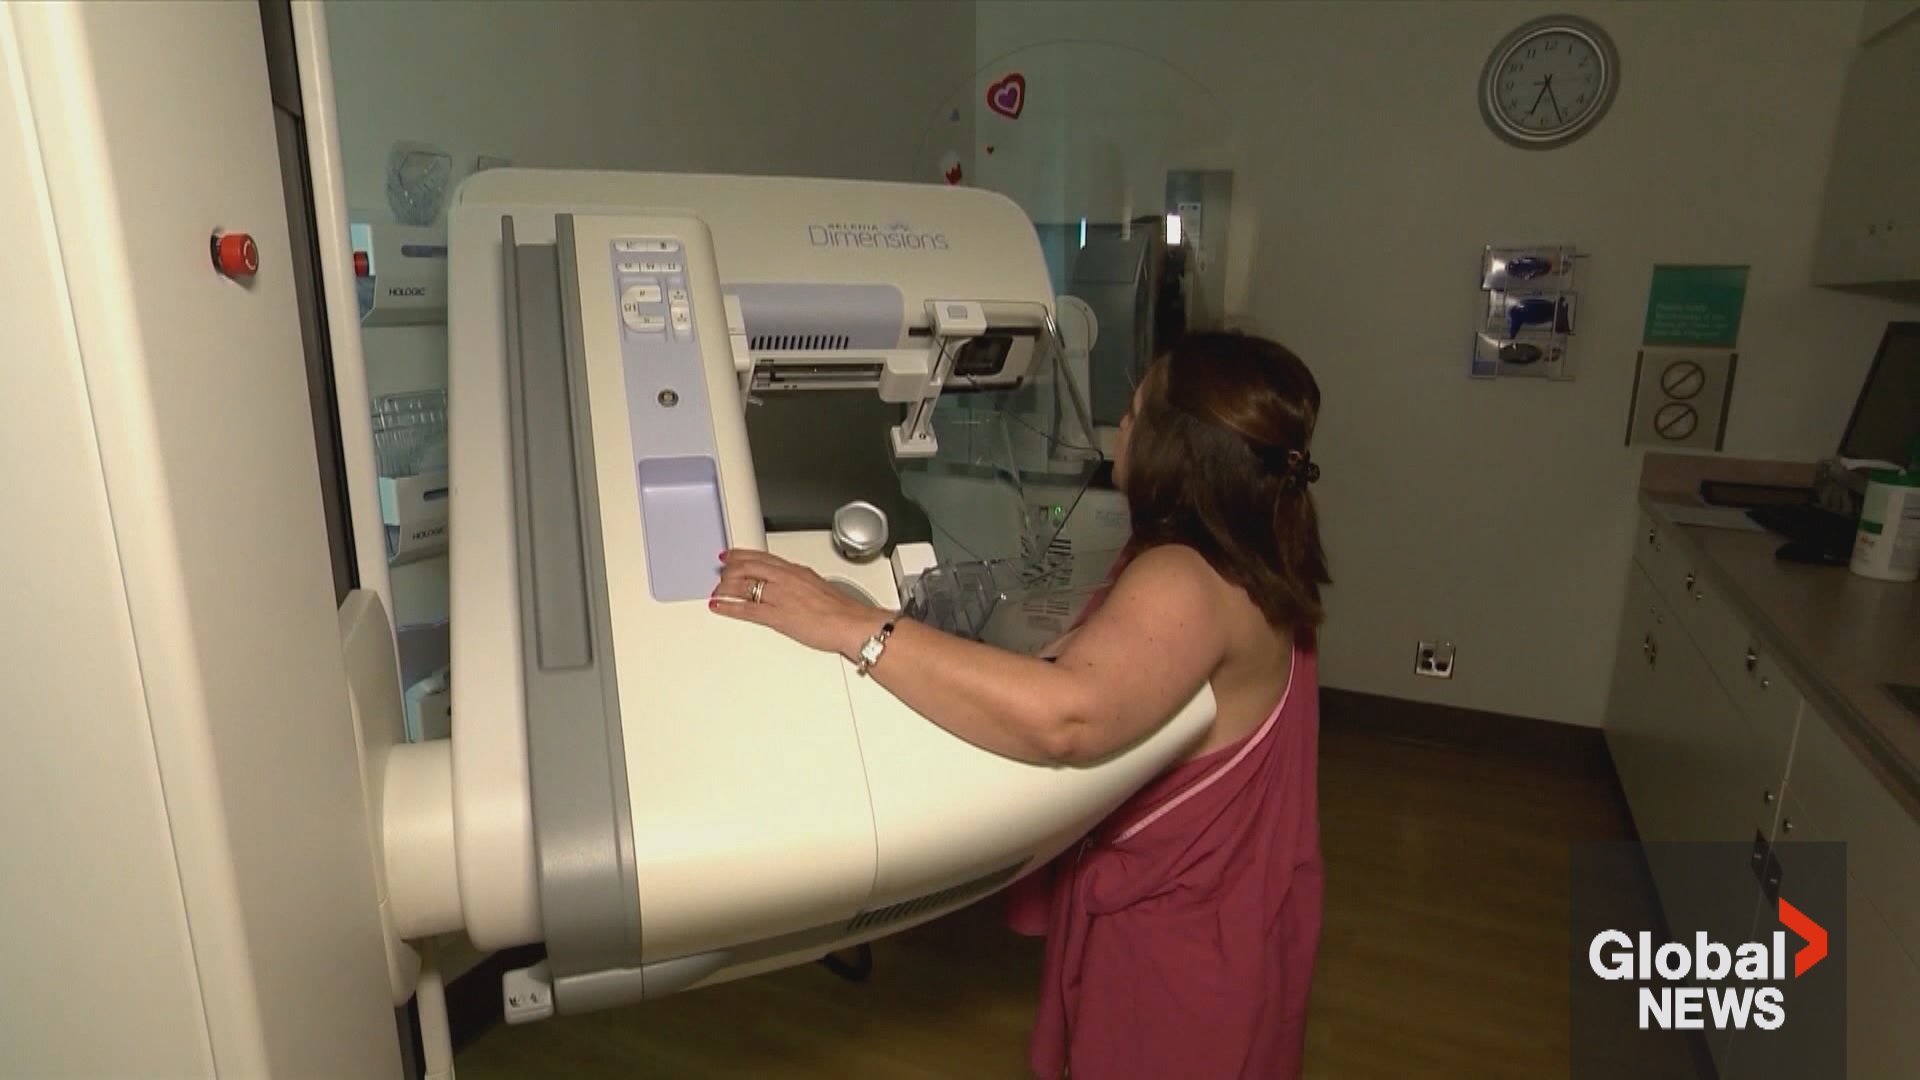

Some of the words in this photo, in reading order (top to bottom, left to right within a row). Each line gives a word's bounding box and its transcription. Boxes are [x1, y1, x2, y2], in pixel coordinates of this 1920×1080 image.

[1544, 40, 1559, 51] 12
[1527, 48, 1537, 59] 11
[808, 224, 949, 249] Dimensions
[388, 286, 426, 297] HOLOGIC
